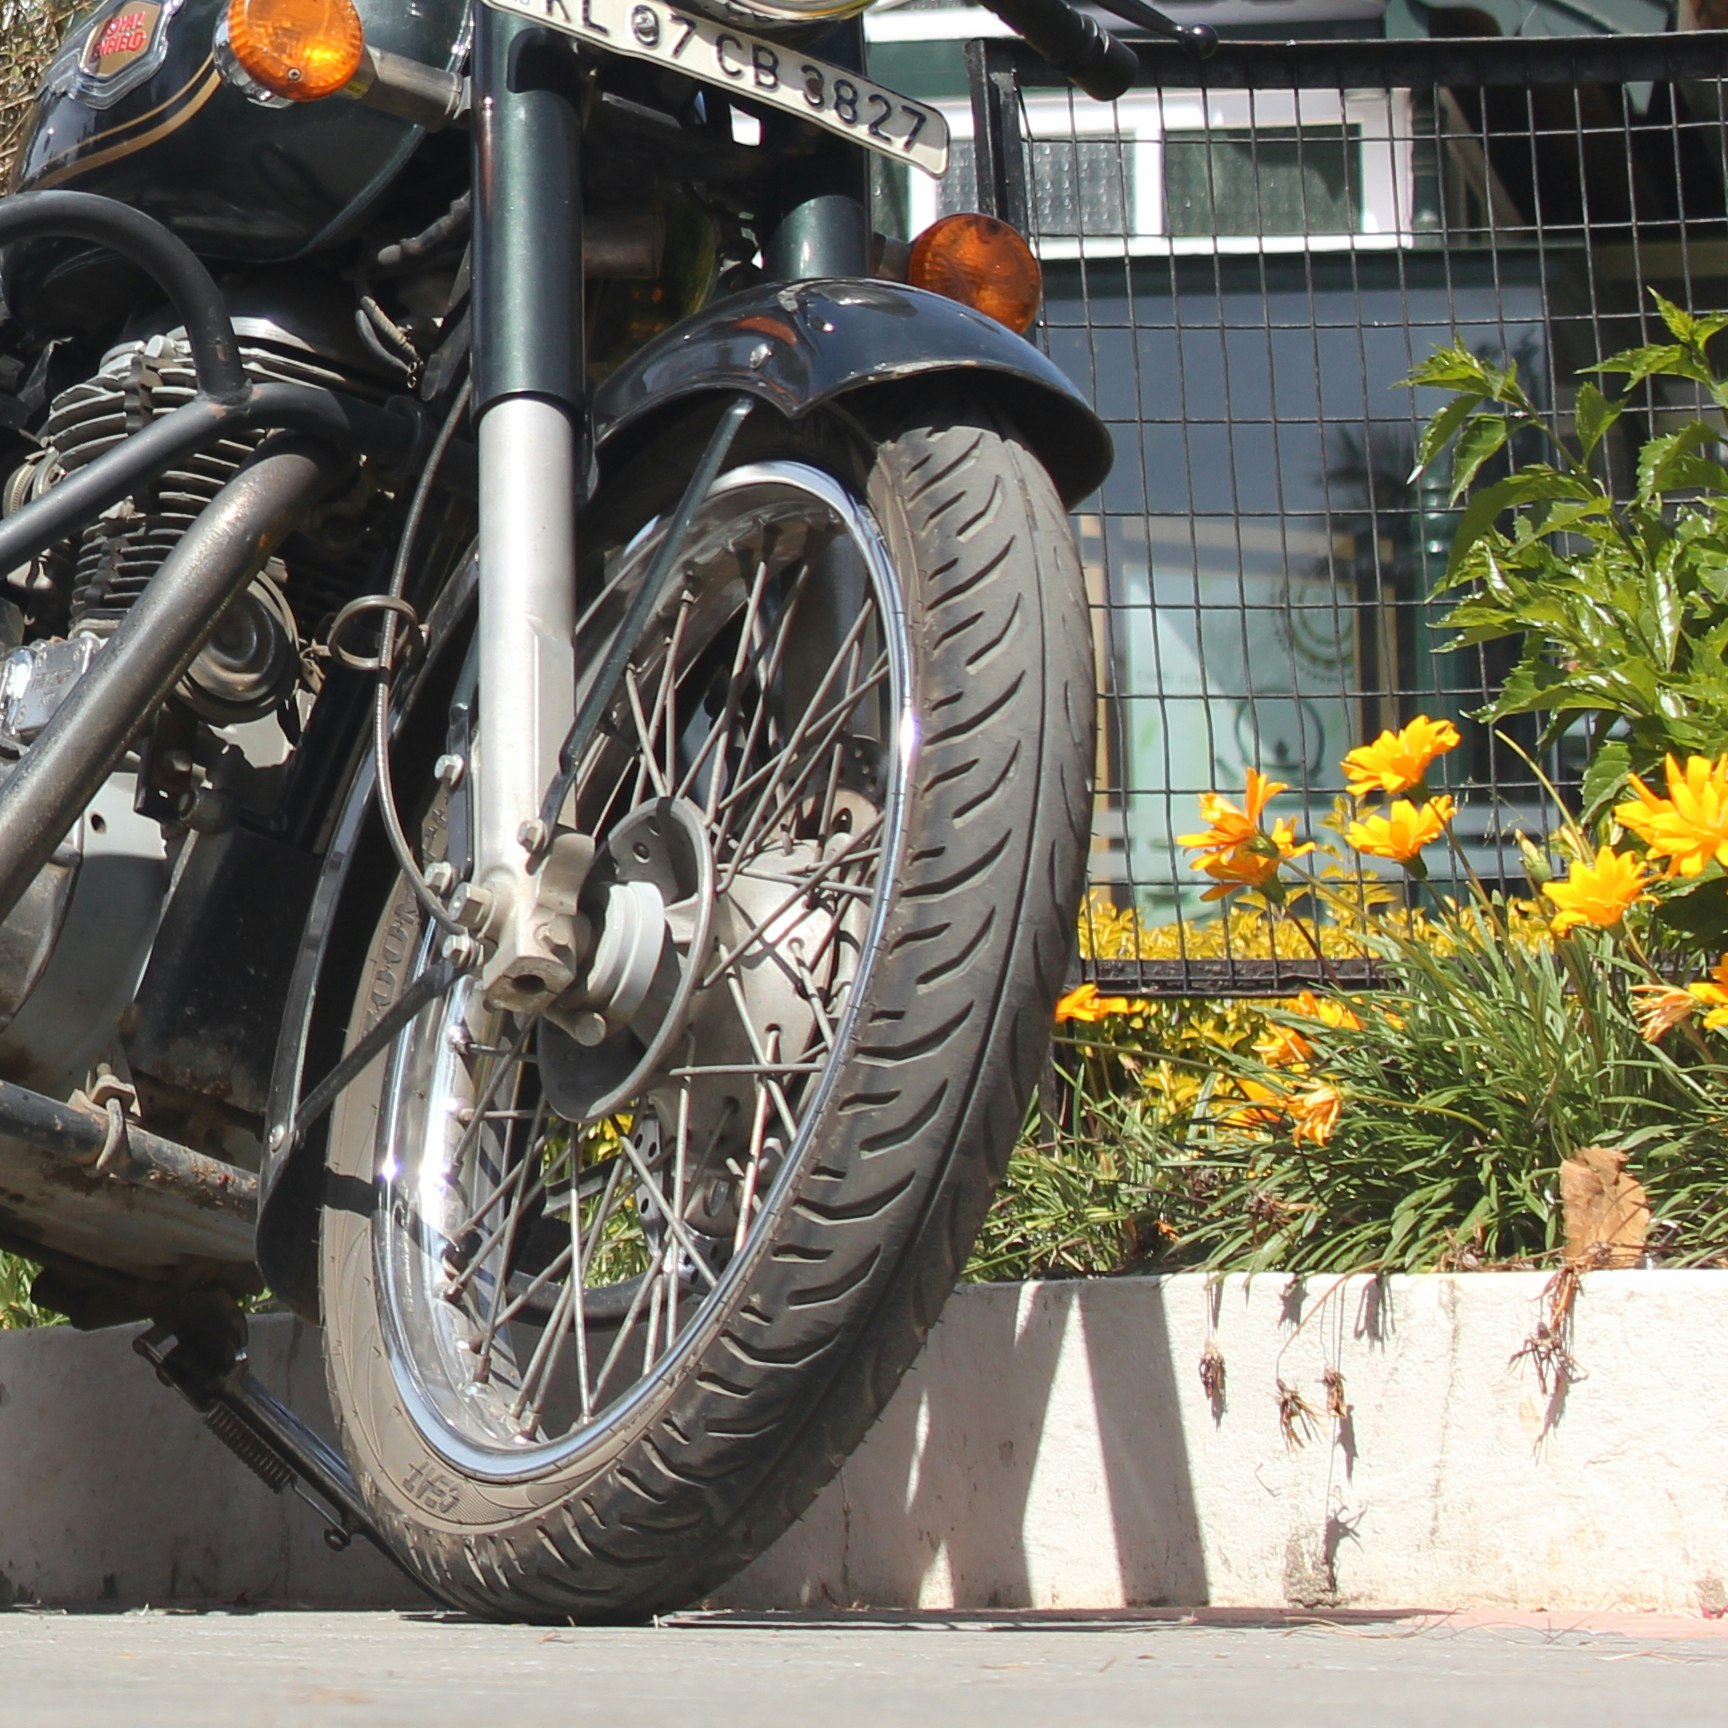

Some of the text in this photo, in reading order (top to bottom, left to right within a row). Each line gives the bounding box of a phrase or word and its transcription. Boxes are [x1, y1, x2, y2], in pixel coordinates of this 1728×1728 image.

[629, 4, 697, 59] 07
[715, 33, 780, 90] CB
[800, 63, 928, 152] 3827
[402, 1461, 463, 1514] CEAT
